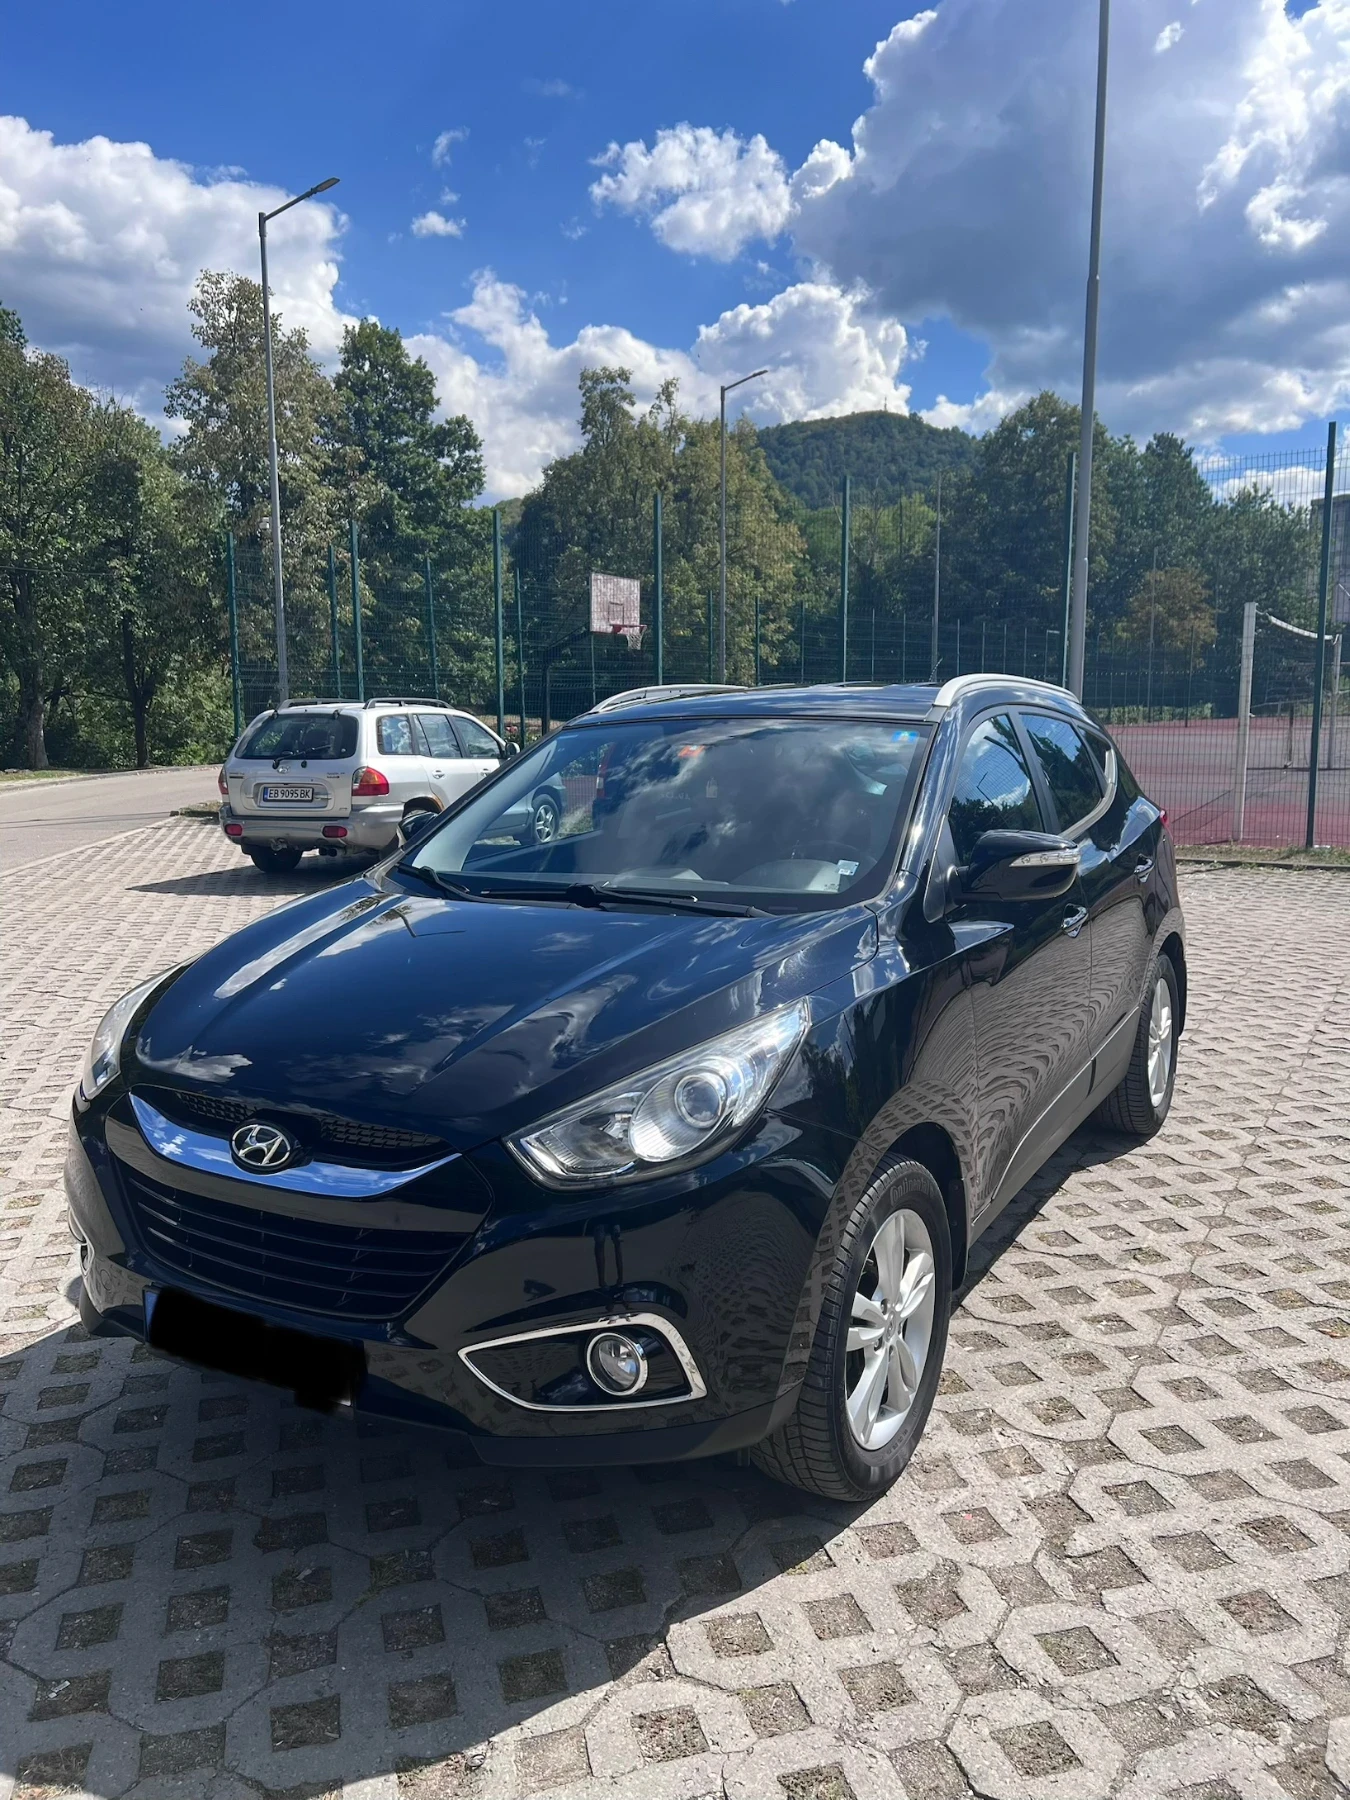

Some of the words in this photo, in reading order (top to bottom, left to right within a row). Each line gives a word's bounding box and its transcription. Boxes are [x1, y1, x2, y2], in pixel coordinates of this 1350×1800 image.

[268, 789, 278, 798] EB
[280, 789, 298, 798] 9095
[300, 789, 310, 798] BK
